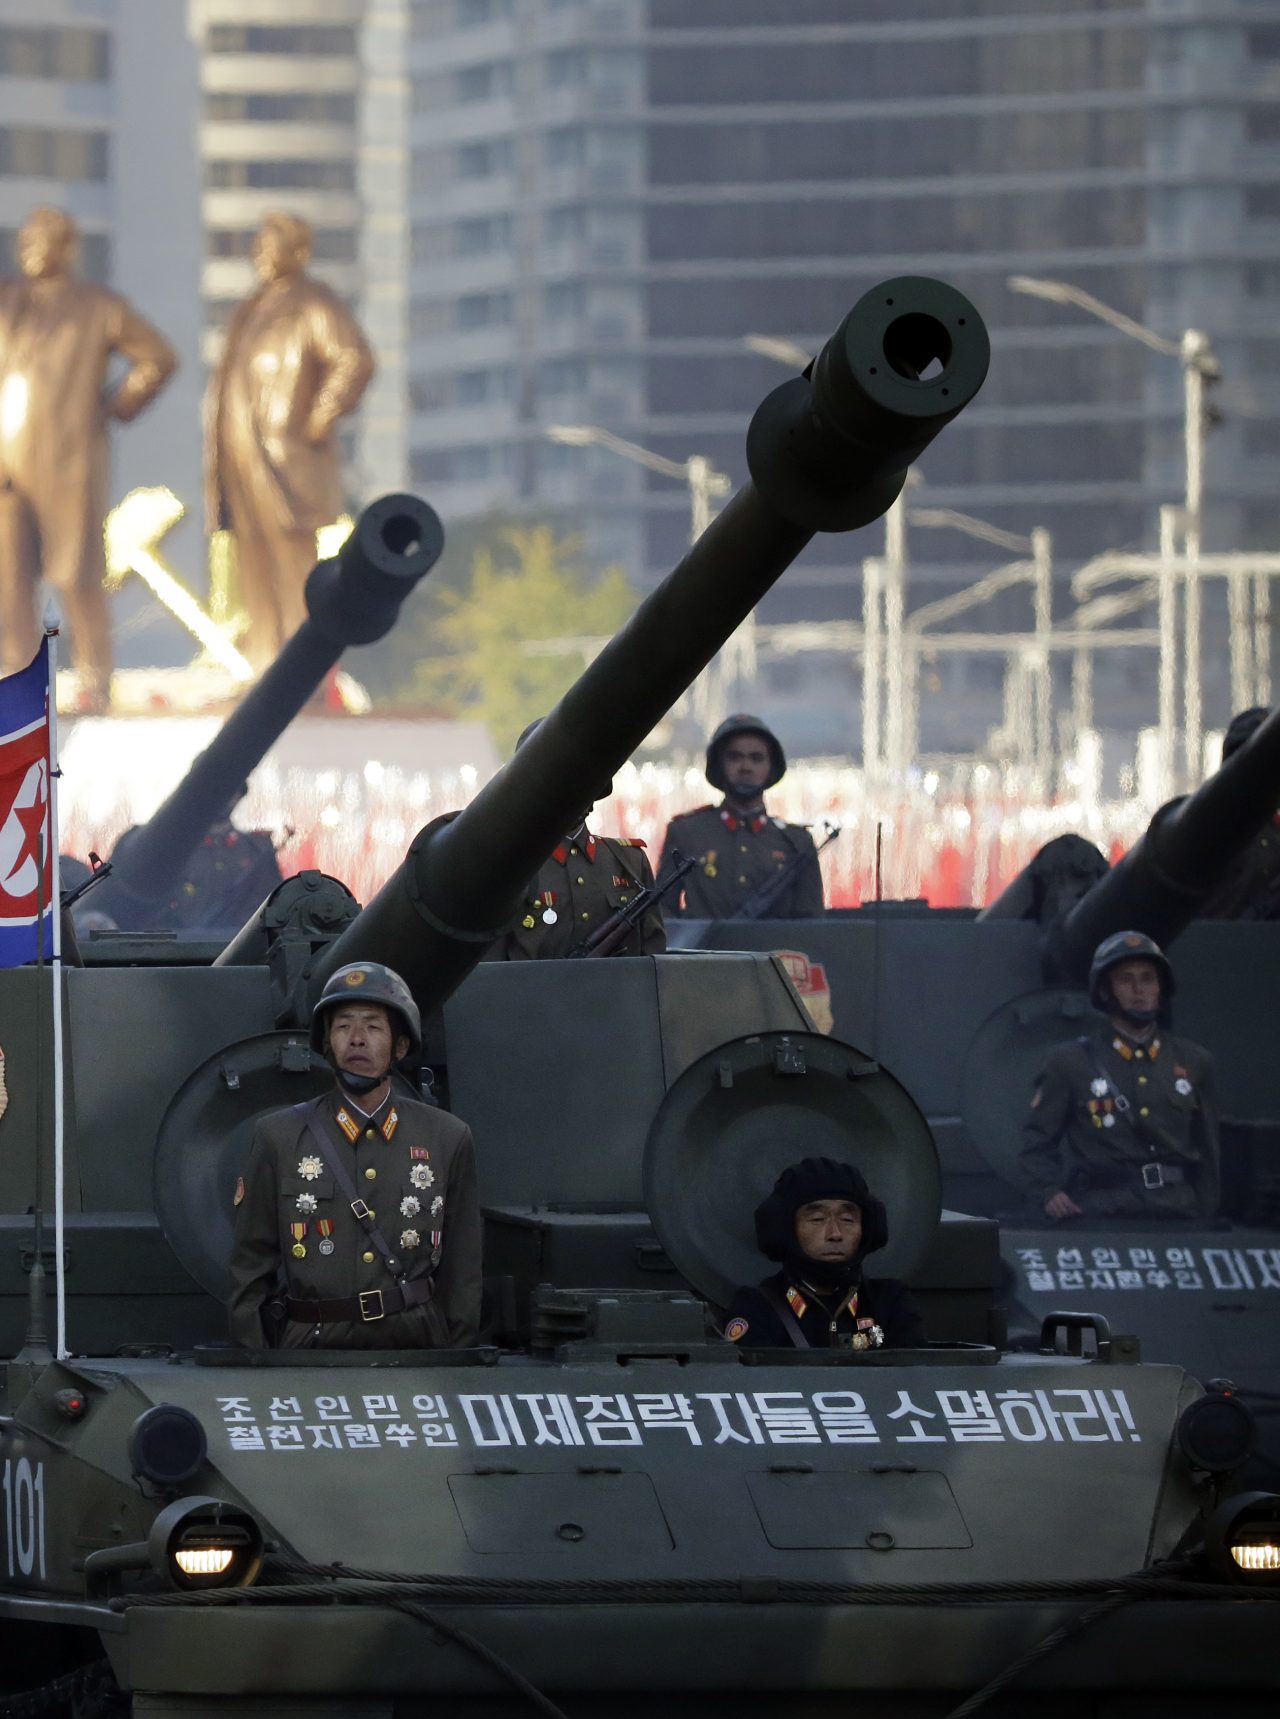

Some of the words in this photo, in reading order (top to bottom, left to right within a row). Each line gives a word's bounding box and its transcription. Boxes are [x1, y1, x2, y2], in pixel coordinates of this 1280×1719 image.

[458, 1391, 881, 1447] 미제침략자들을
[887, 1389, 1142, 1444] 소멸하라!
[2, 1456, 47, 1581] 101
